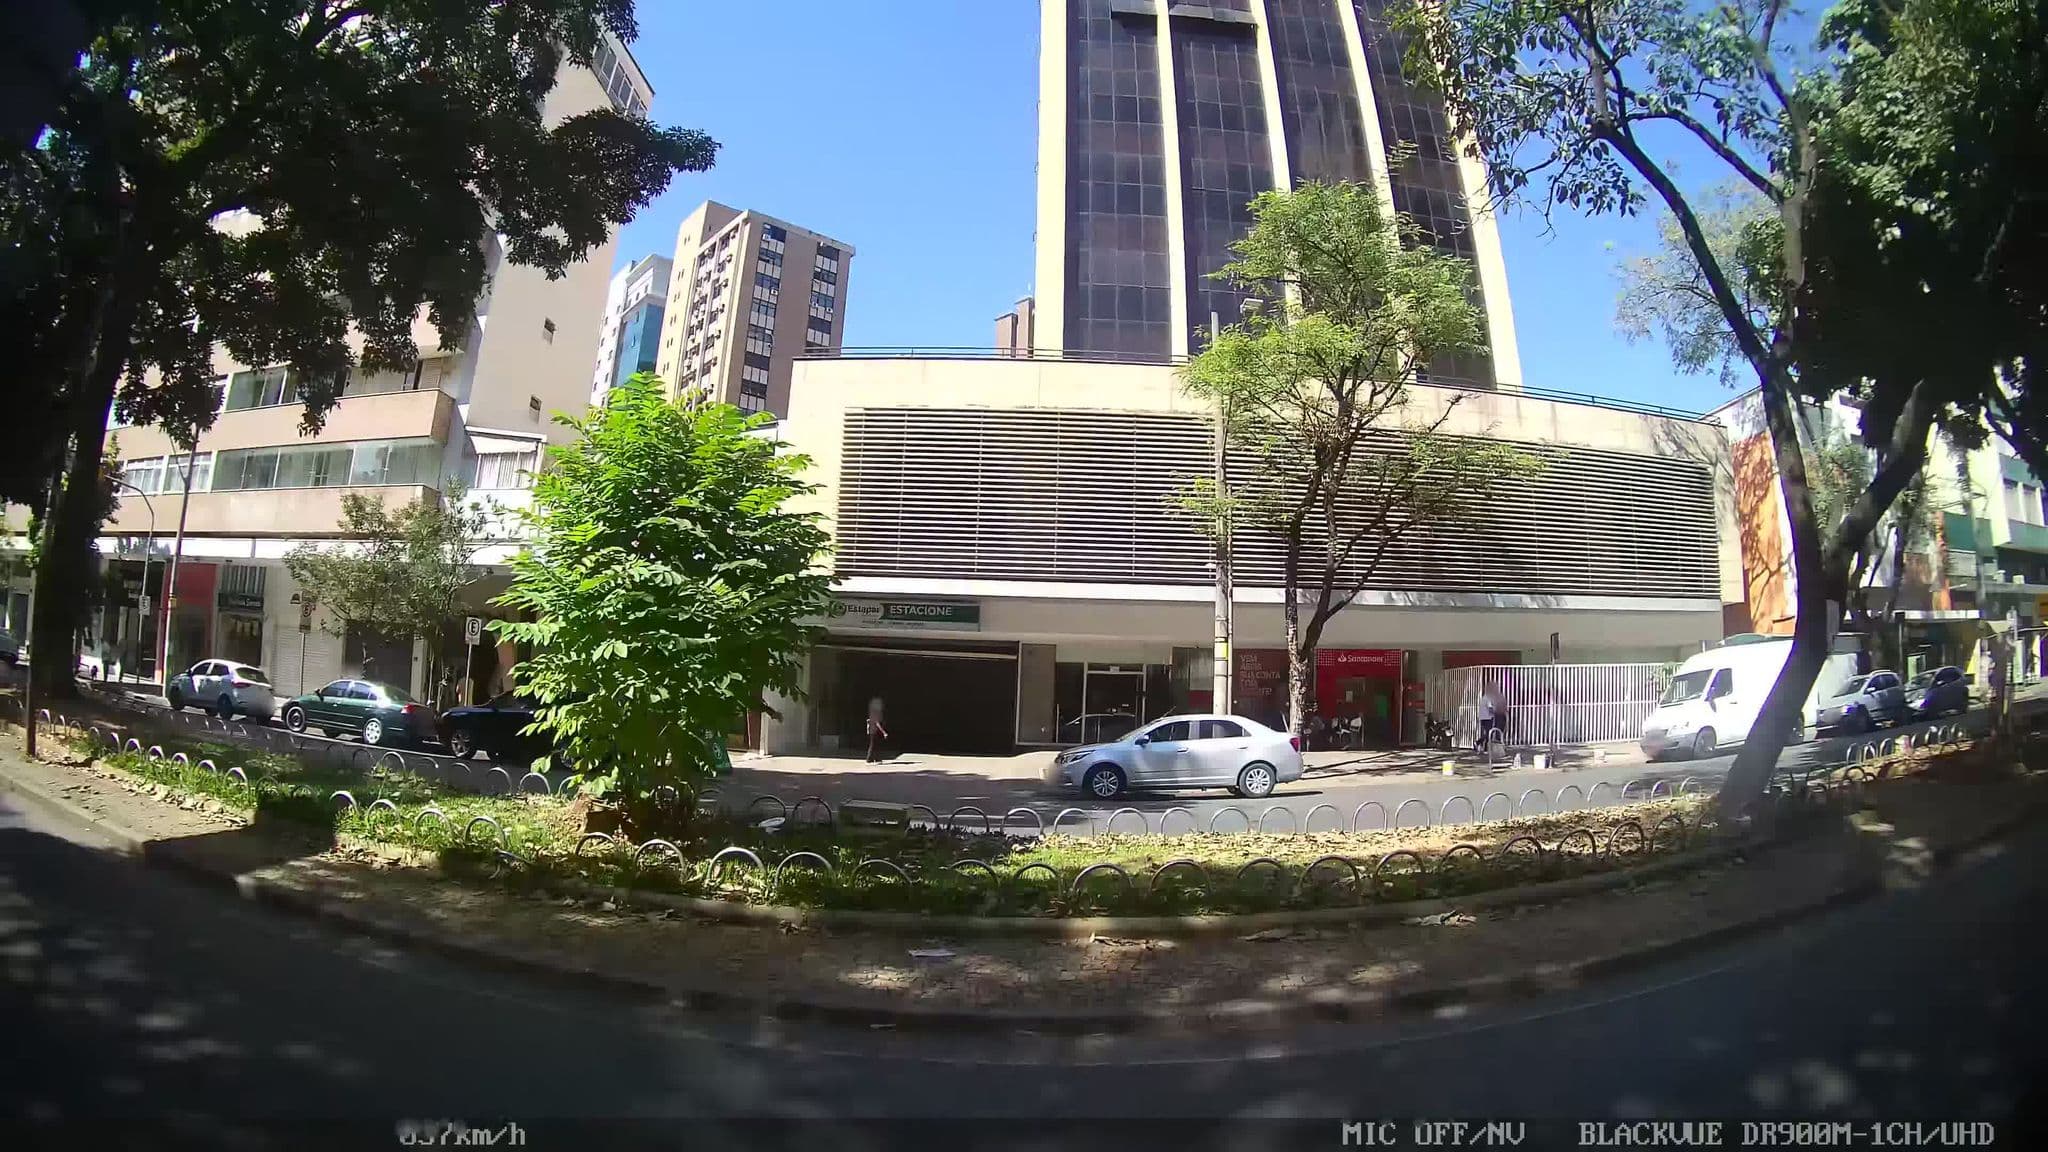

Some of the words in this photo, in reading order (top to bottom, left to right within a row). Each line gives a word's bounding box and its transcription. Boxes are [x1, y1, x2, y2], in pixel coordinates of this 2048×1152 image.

[847, 604, 880, 615] Estapar
[889, 604, 953, 616] ESTACIONE
[1347, 654, 1385, 663] Santander
